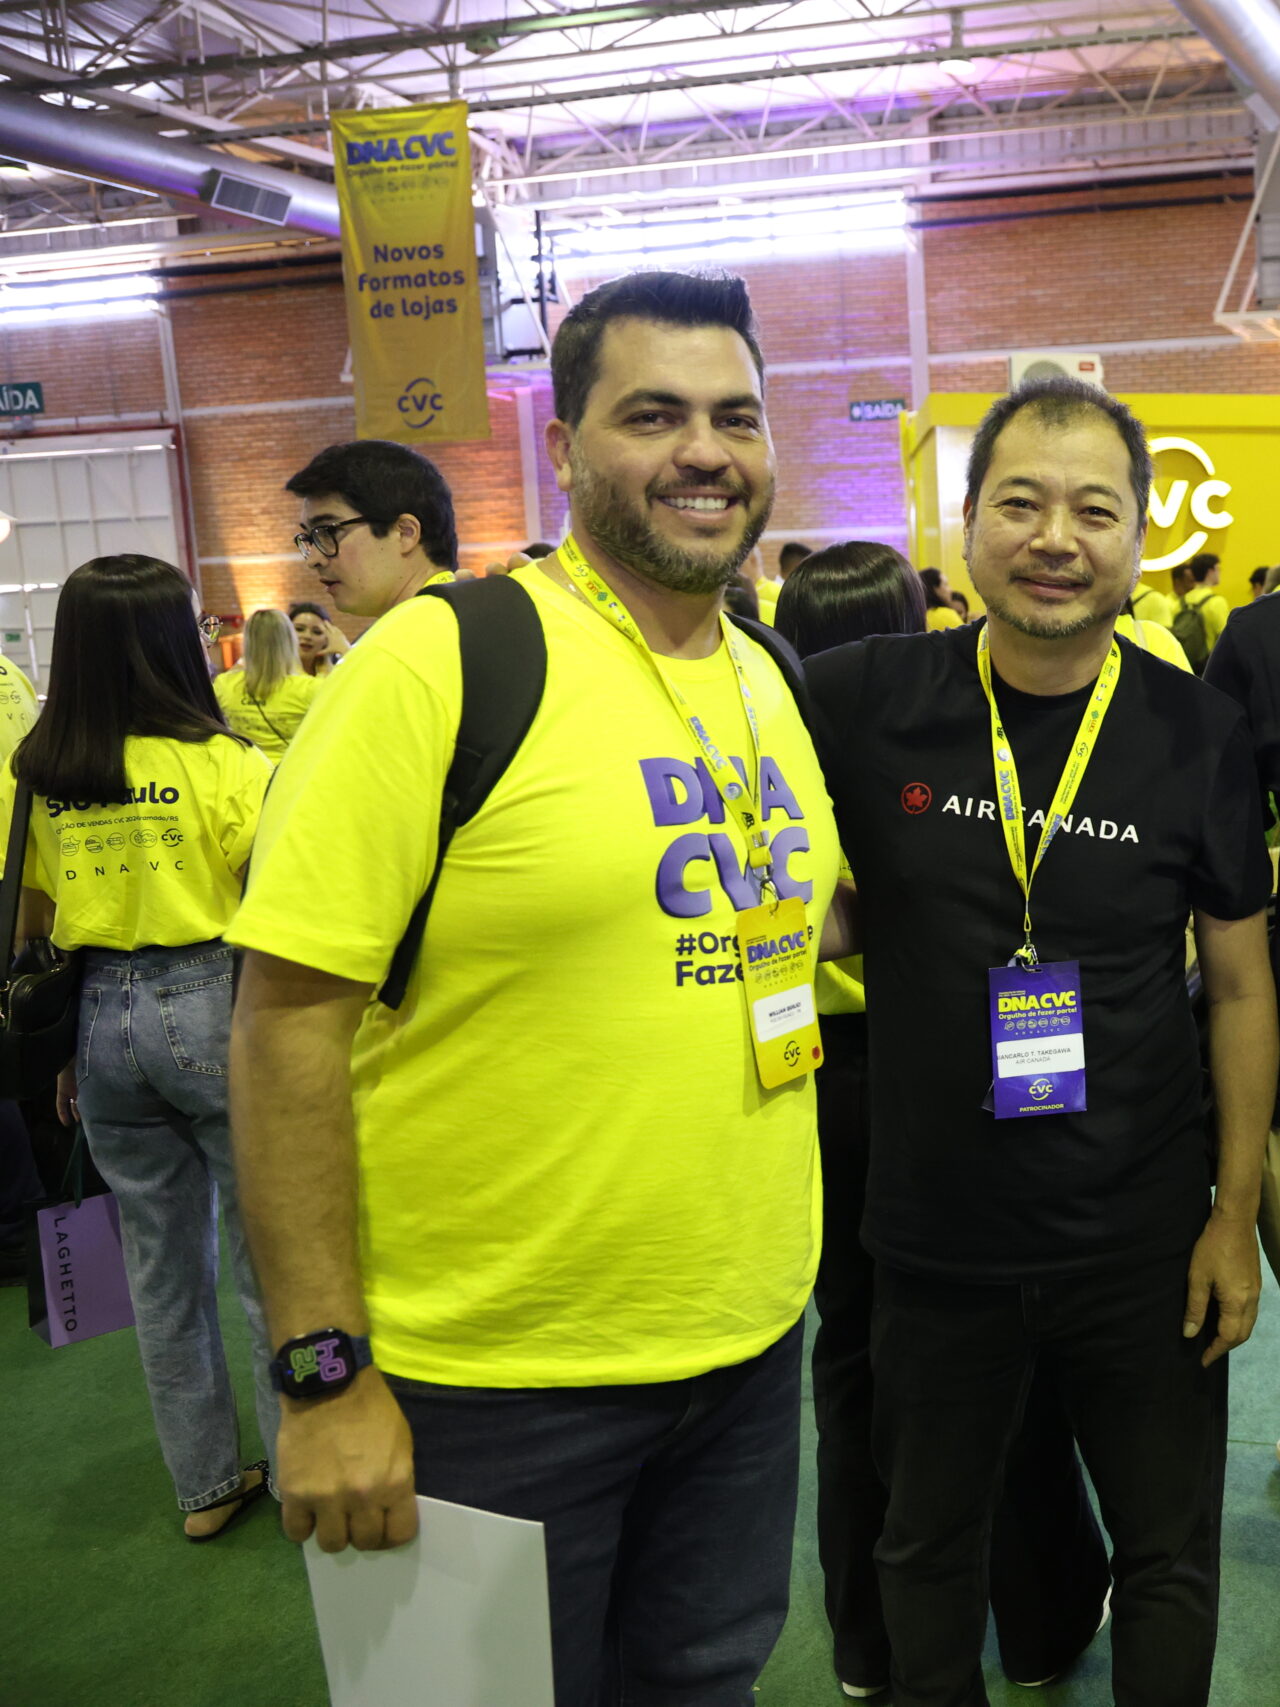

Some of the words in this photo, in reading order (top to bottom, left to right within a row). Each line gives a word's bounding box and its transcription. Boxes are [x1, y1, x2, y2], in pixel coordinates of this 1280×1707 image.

[373, 243, 444, 263] Novos
[370, 300, 394, 319] de
[401, 295, 458, 320] lojas
[397, 393, 444, 413] CVC
[1148, 479, 1235, 530] VC
[638, 756, 805, 828] DNA
[942, 795, 996, 820] AIR
[1021, 806, 1140, 843] ANADA
[161, 832, 184, 844] CVC
[655, 827, 813, 918] CVC
[998, 1012, 1027, 1020] Orgulho
[784, 1046, 801, 1061] CVC
[998, 1051, 1030, 1060] IANCARLO
[1037, 1047, 1071, 1056] TAKEGAWA
[1028, 1084, 1053, 1095] CVC
[1019, 1103, 1065, 1113] PATROCINADOR
[54, 1216, 78, 1332] LAGHETTO
